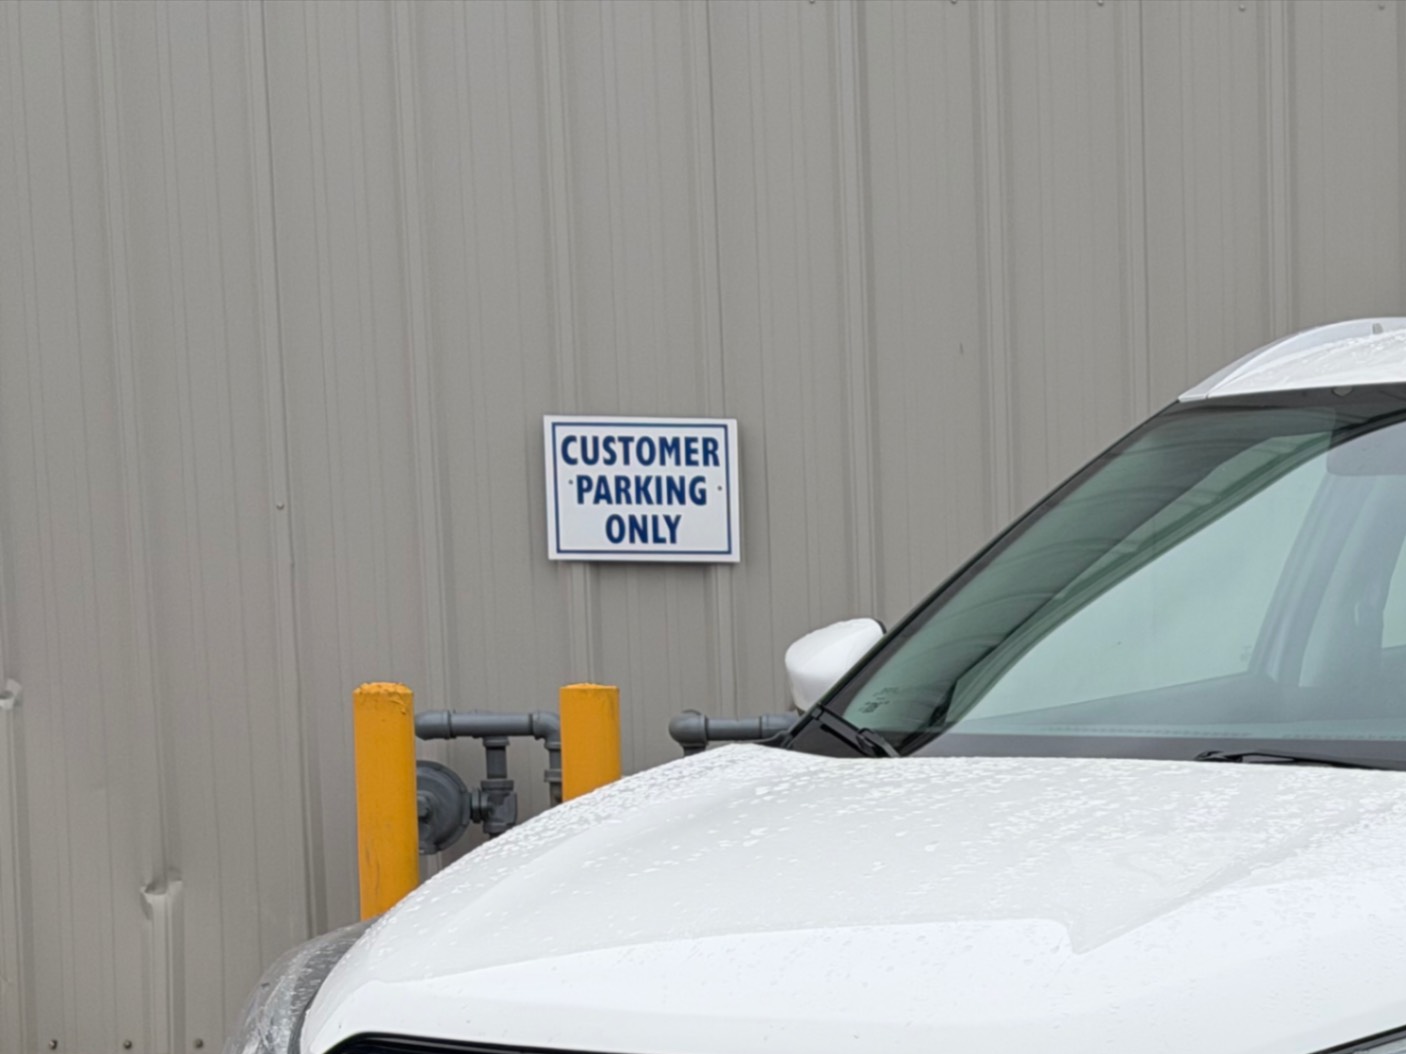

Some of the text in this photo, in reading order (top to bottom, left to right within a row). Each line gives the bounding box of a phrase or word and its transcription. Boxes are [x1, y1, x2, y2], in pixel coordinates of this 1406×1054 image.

[560, 434, 720, 467] CUSTOMER
[576, 474, 708, 506] PARKING
[605, 513, 682, 545] ONLY
